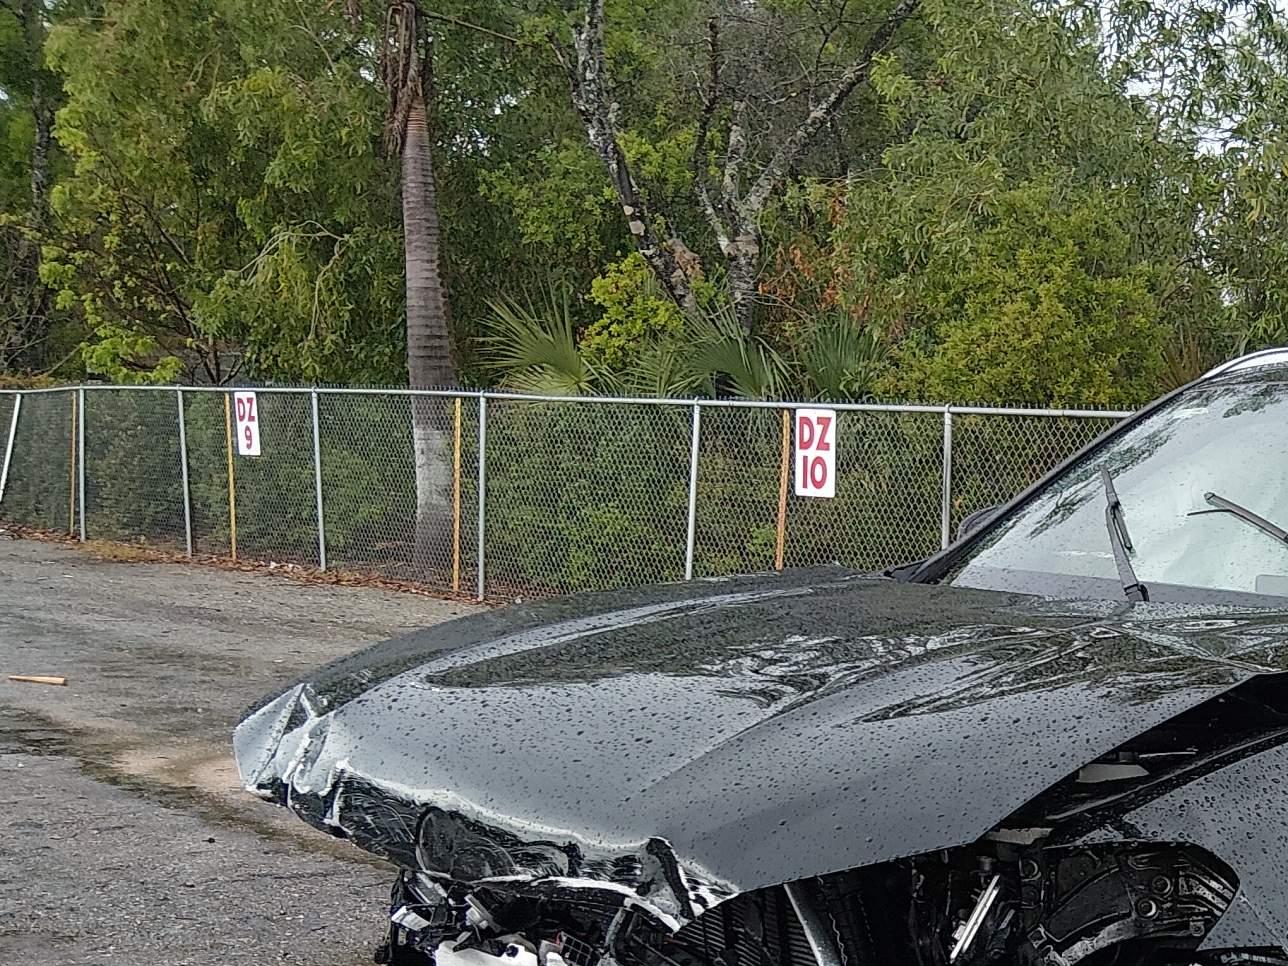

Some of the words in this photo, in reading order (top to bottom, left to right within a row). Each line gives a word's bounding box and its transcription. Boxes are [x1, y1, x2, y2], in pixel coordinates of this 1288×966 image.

[236, 397, 256, 423] DZ
[244, 425, 253, 450] 9
[799, 416, 832, 451] DZ
[802, 455, 828, 490] 10
